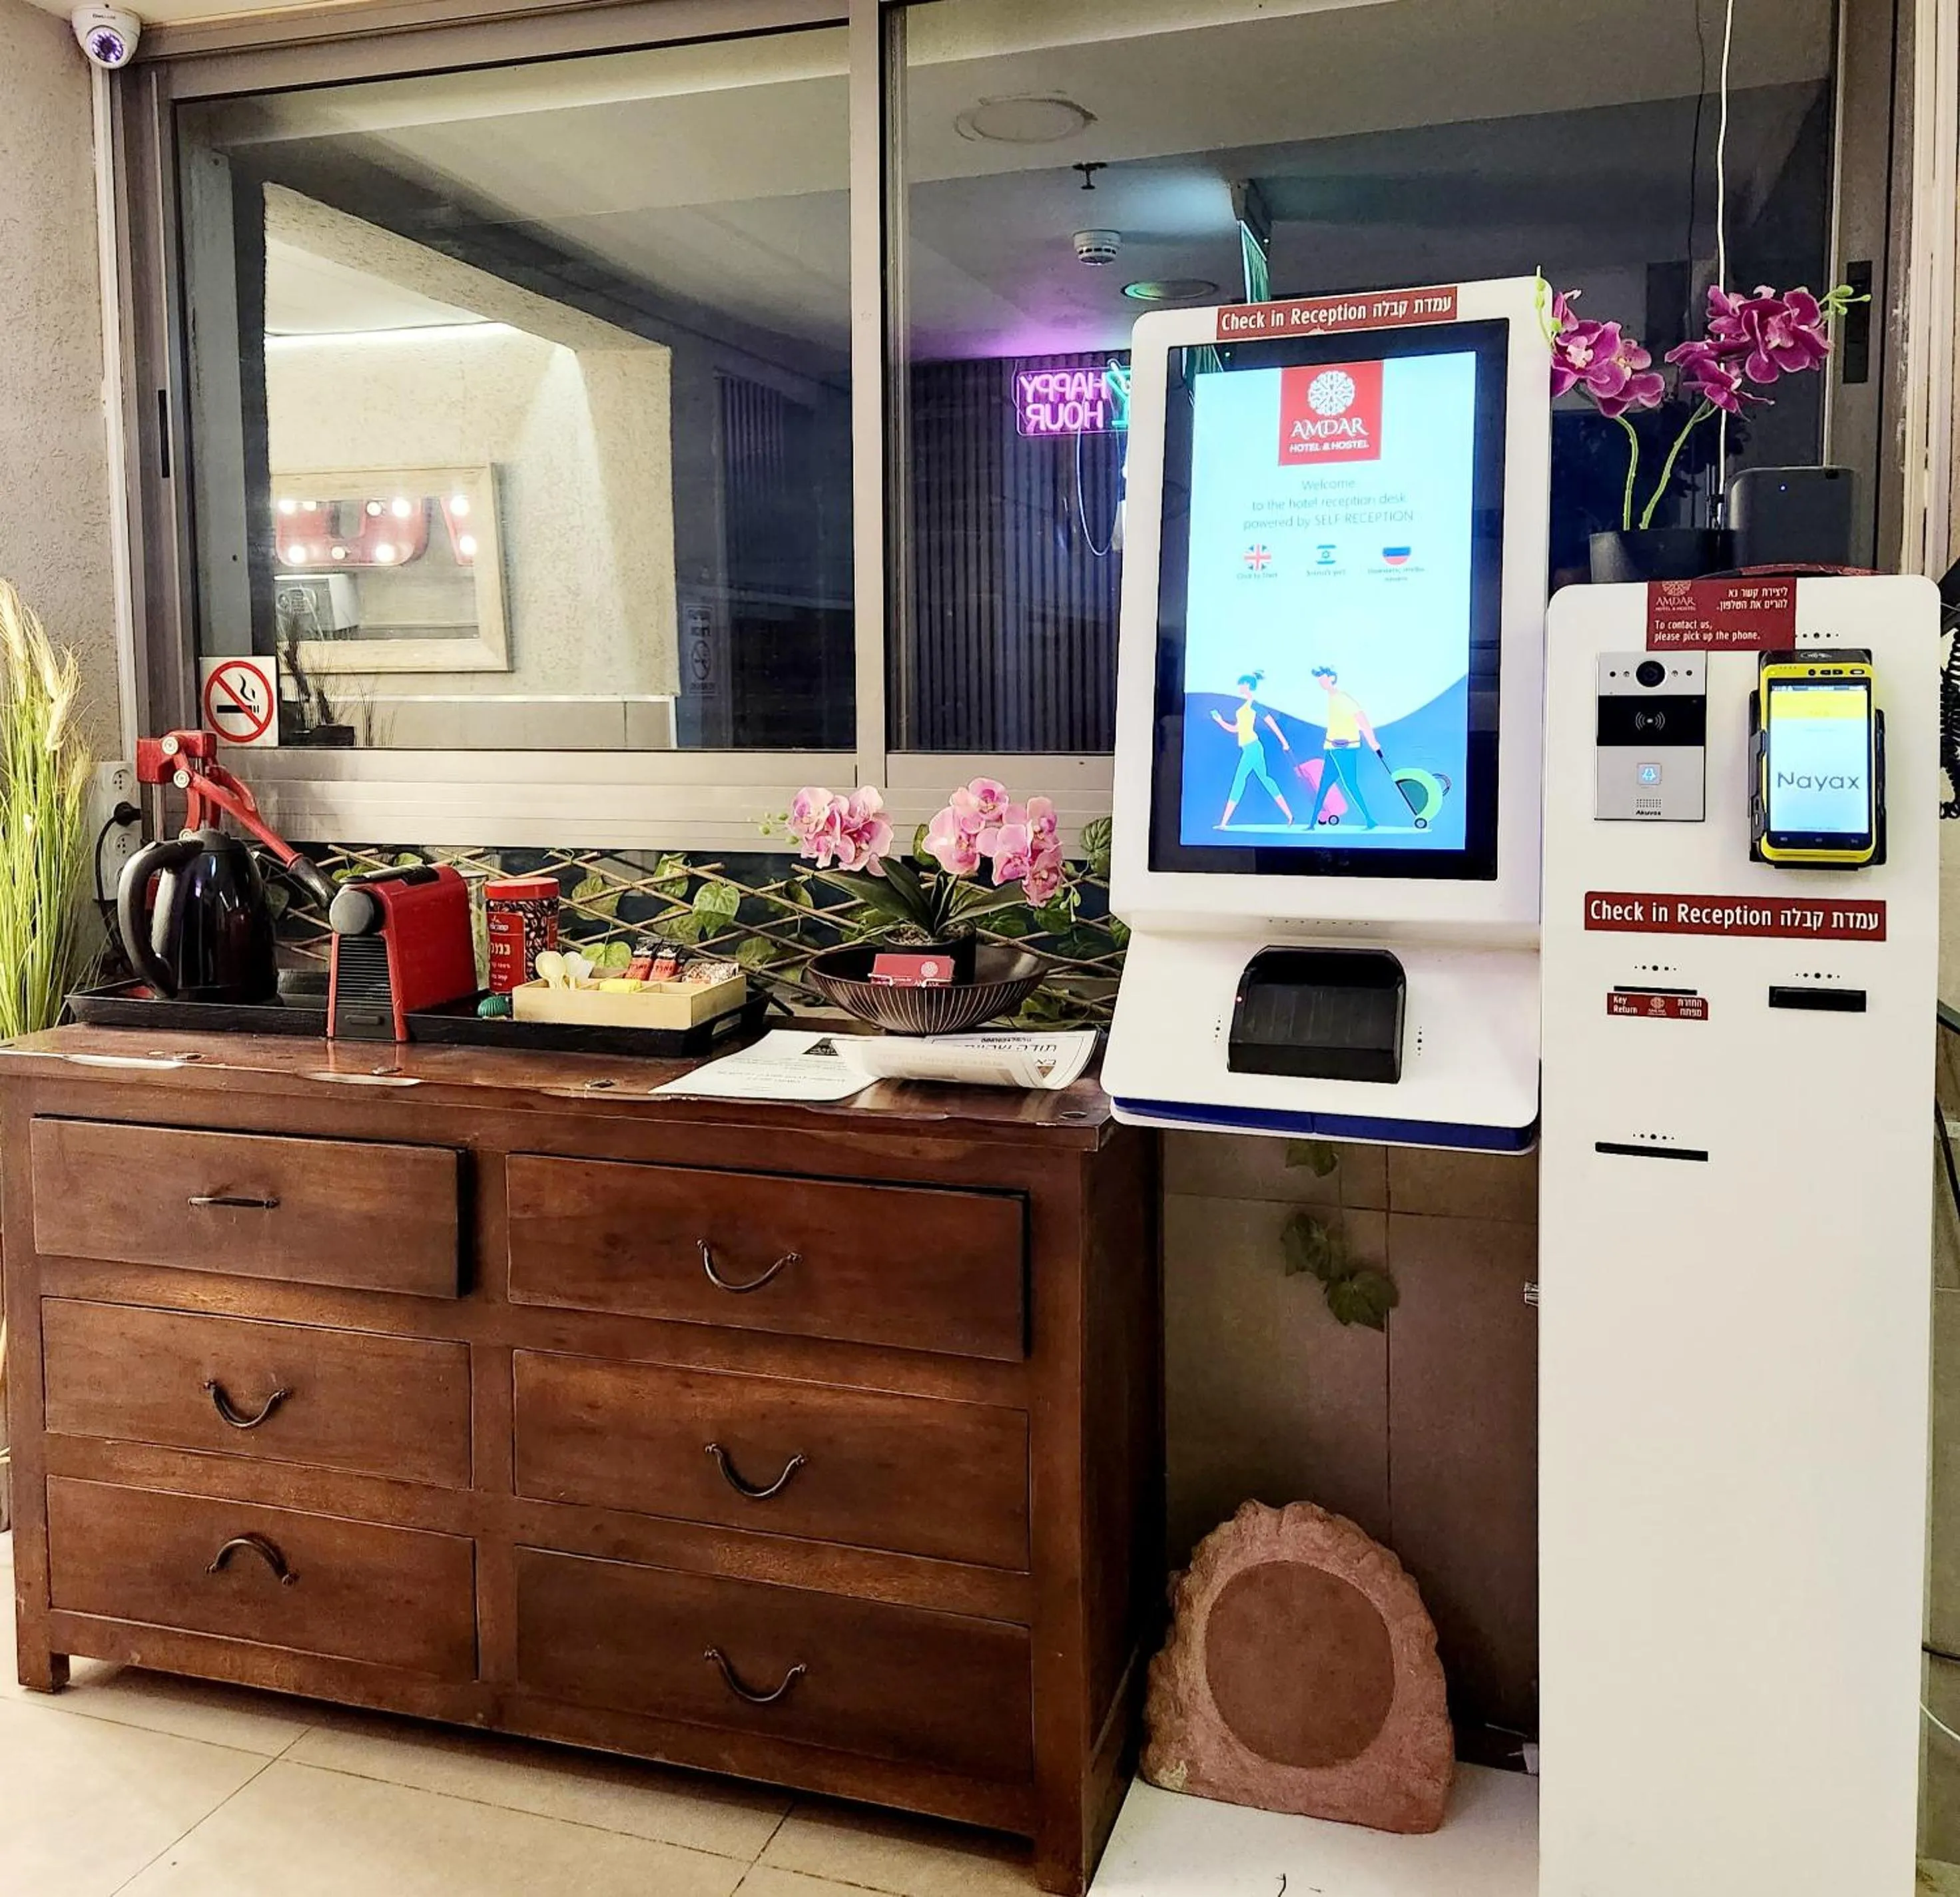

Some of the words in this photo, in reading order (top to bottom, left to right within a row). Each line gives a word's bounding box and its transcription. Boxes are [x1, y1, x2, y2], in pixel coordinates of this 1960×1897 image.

[1373, 299, 1407, 318] קבלה
[1413, 295, 1453, 313] עמדת
[1221, 311, 1265, 331] Check
[1271, 308, 1284, 327] in
[1291, 304, 1367, 325] Reception
[1291, 417, 1369, 439] AMDAR
[1289, 442, 1321, 453] HOTEL
[1331, 439, 1370, 450] HOSTEL
[1301, 479, 1356, 491] Welcome
[1252, 501, 1264, 511] to
[1267, 499, 1285, 511] the
[1289, 497, 1317, 509] hotel
[1321, 495, 1375, 510] reception
[1379, 491, 1406, 504] desk
[1243, 515, 1293, 532] powered
[1297, 515, 1311, 529] by
[1315, 513, 1340, 526] SELF
[1345, 509, 1413, 525] RECEPTION
[1728, 589, 1738, 598] נא
[1741, 588, 1758, 599] קשר
[1762, 587, 1788, 597] ליצירת
[1656, 596, 1696, 607] AMDAR
[1750, 600, 1762, 609] את
[1764, 599, 1788, 609] להרים
[1654, 620, 1665, 630] To
[1668, 620, 1697, 630] contact
[1700, 621, 1713, 631] us,
[1654, 631, 1680, 643] please
[1683, 630, 1699, 642] pick
[1703, 633, 1714, 643] up
[1716, 631, 1729, 641] the
[1732, 631, 1761, 642] phone.
[1777, 771, 1860, 790] Nayax
[1590, 900, 1644, 922] Check
[1652, 902, 1668, 923] in
[1677, 903, 1772, 929] Reception
[1780, 907, 1824, 931] קבלה
[1831, 910, 1879, 930] עמדת
[1613, 995, 1627, 1005] Key
[1613, 1005, 1638, 1014] Return
